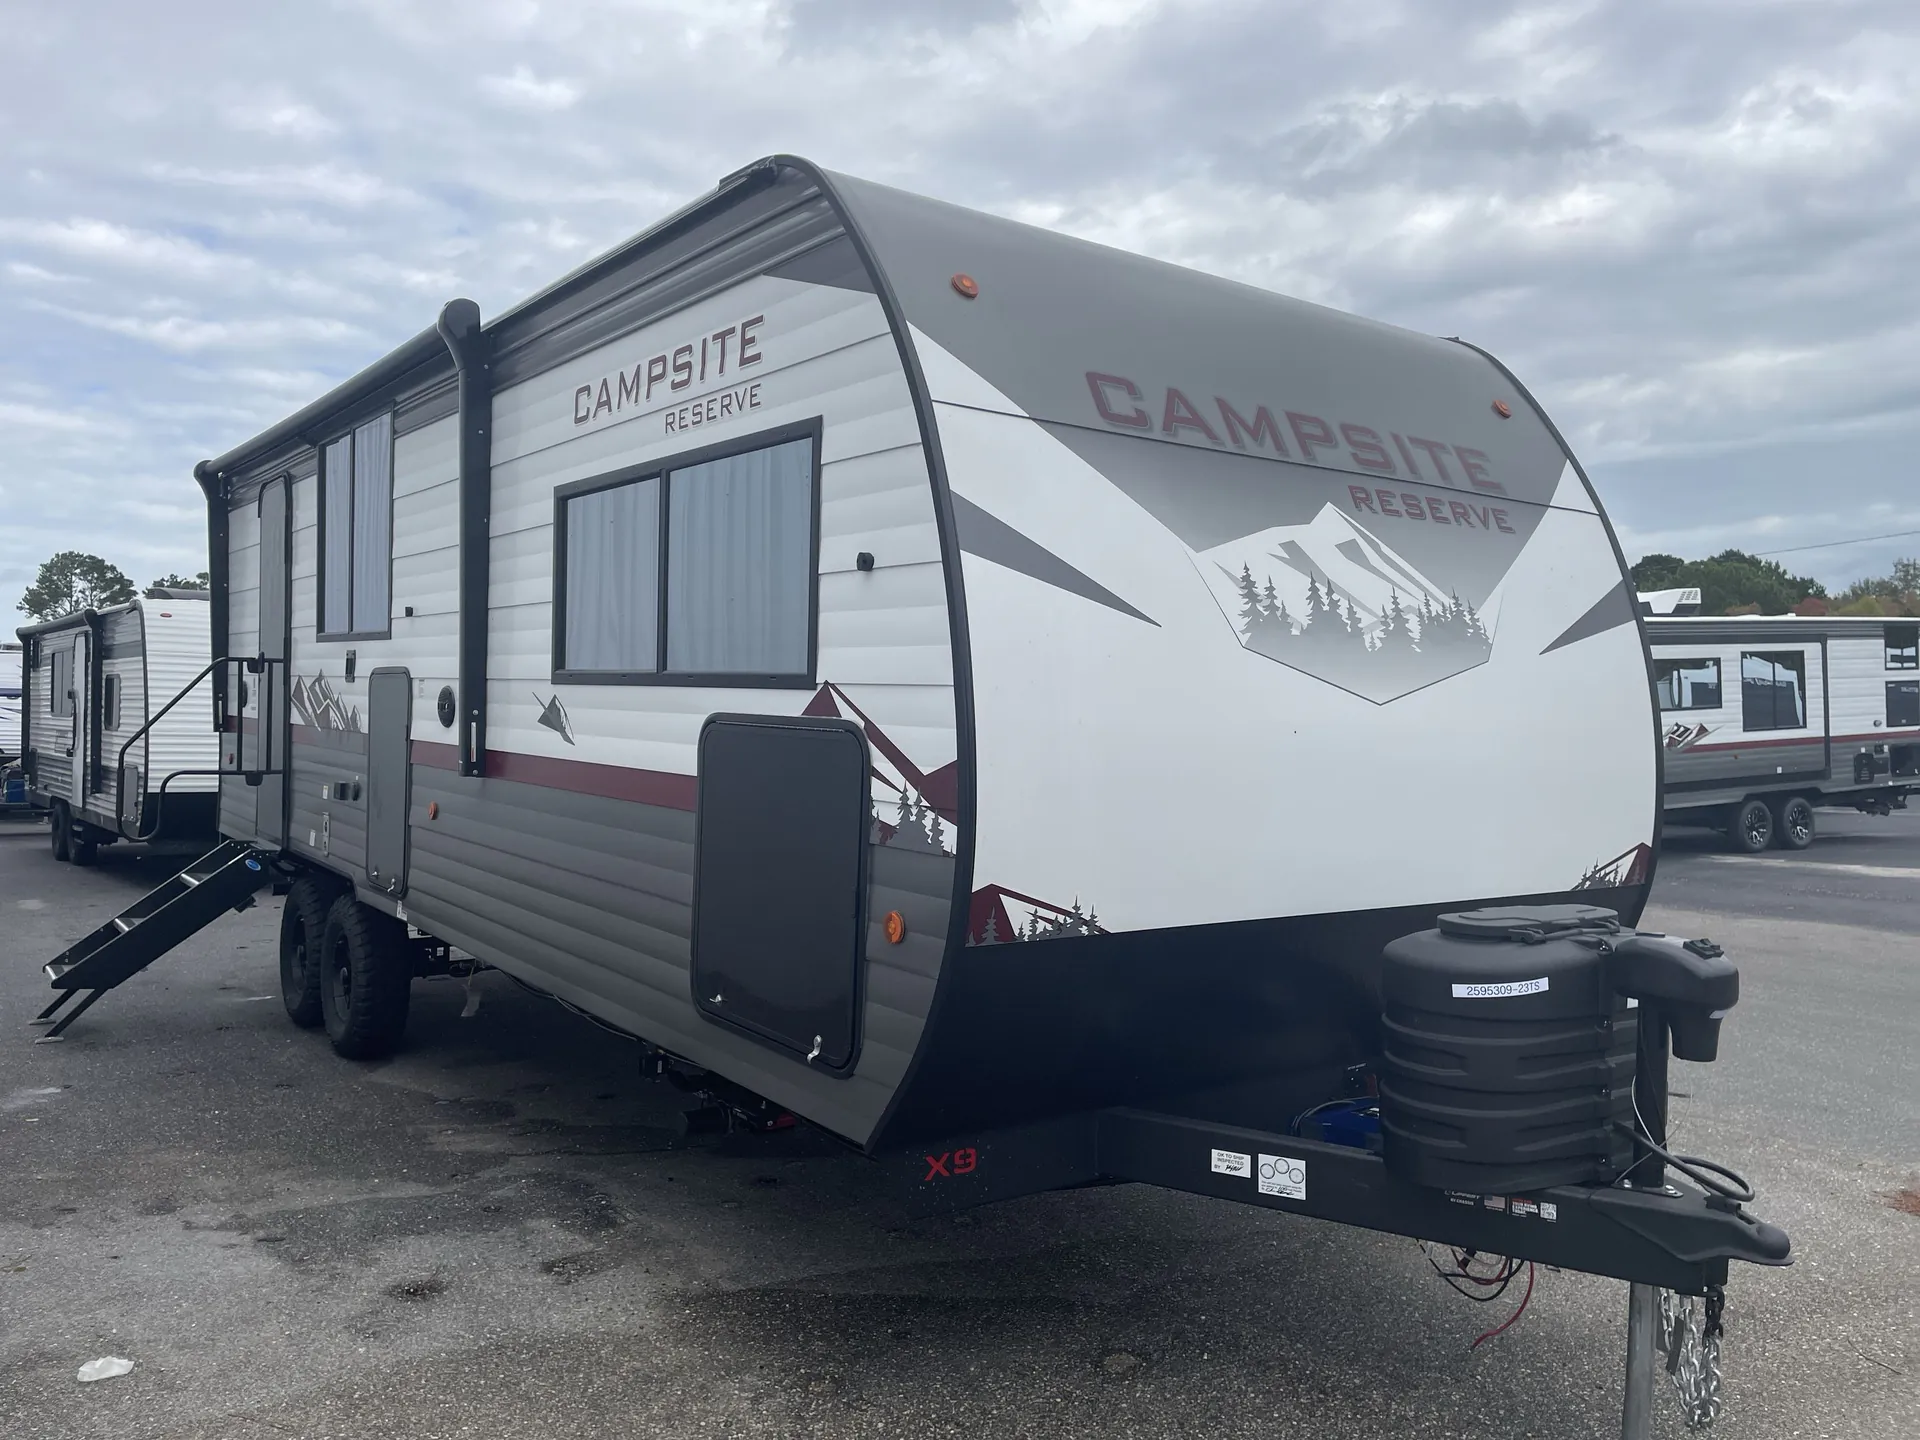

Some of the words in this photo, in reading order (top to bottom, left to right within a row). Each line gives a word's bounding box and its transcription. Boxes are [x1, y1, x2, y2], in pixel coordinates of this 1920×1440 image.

[574, 314, 764, 425] CAMPSITE
[665, 383, 761, 434] RESERVE
[1085, 371, 1506, 493] CAMPSITE
[1348, 485, 1516, 533] RESERVE
[1466, 981, 1540, 996] 2595309-23TS
[924, 1148, 977, 1181] X9
